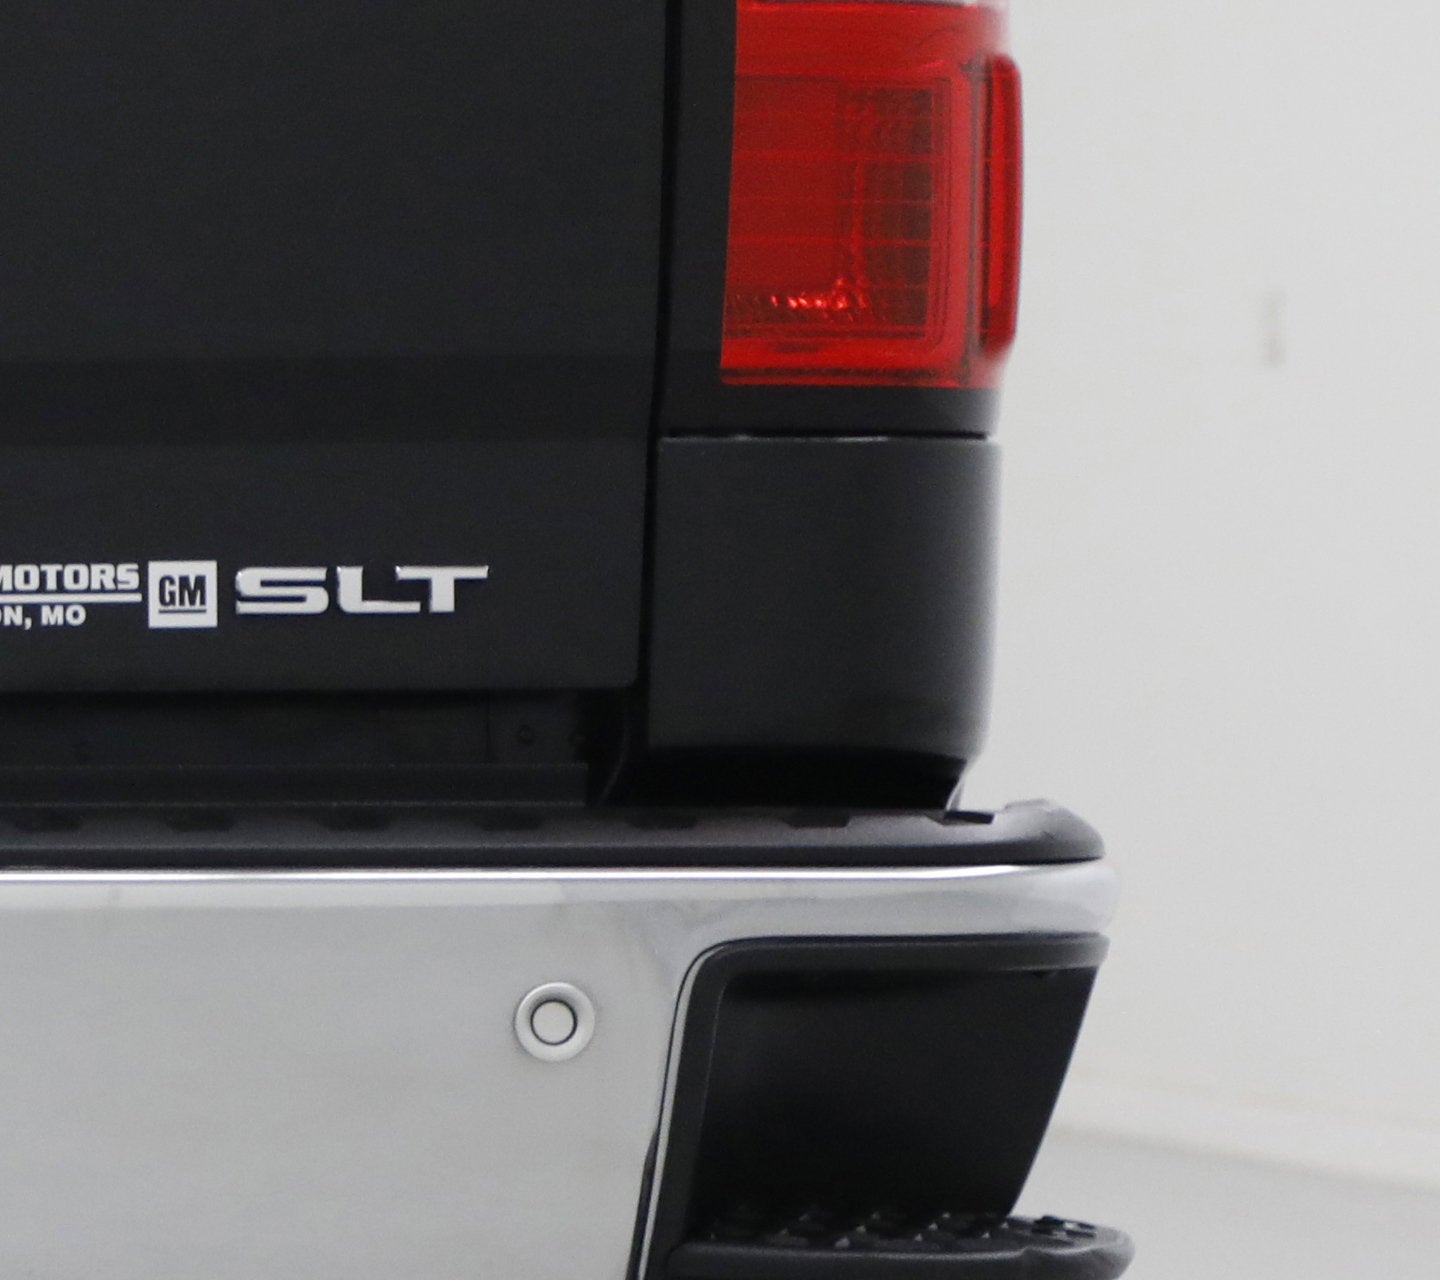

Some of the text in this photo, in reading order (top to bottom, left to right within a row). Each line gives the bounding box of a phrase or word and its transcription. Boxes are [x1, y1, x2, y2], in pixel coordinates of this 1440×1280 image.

[158, 574, 207, 608] GM
[235, 564, 490, 615] SLT
[41, 604, 88, 627] MO
